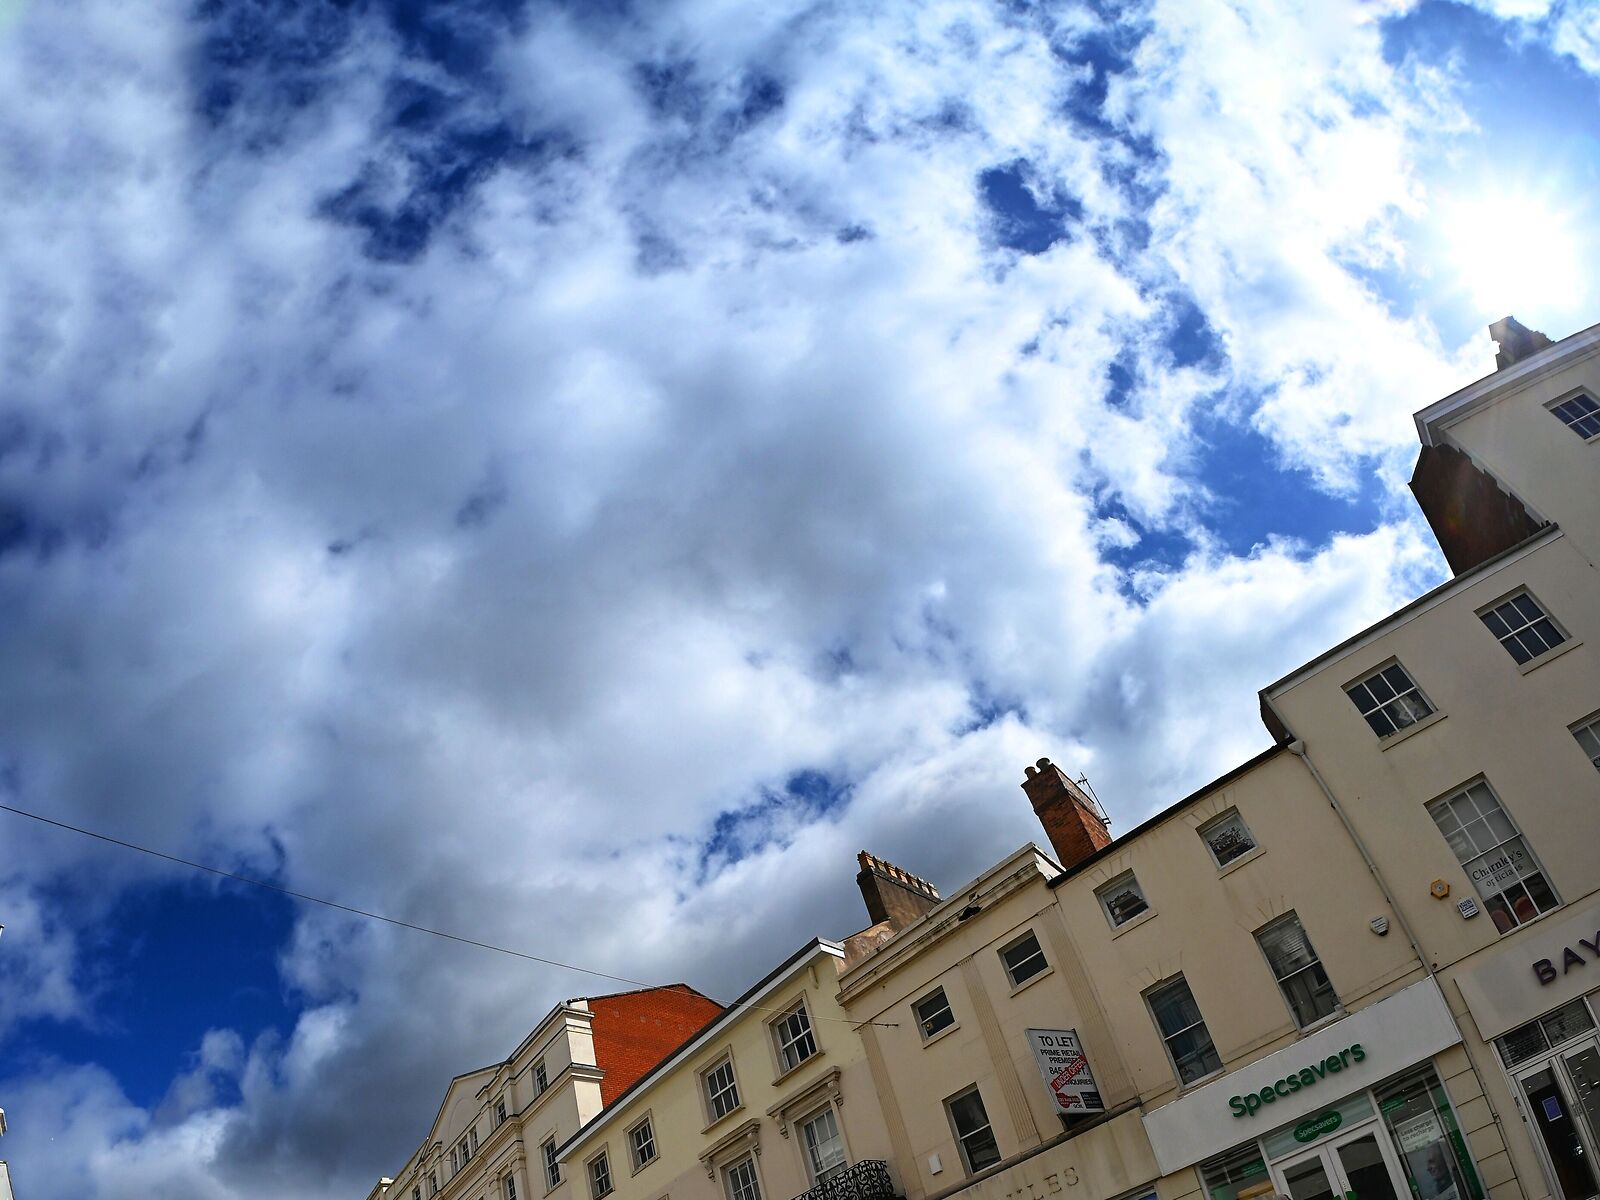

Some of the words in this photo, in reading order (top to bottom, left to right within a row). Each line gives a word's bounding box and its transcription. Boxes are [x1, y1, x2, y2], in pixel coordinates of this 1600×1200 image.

[1472, 849, 1523, 882] Charnley's
[1038, 1035, 1054, 1047] TO
[1055, 1036, 1074, 1047] LET
[1040, 1048, 1060, 1057] PRIME
[1049, 1066, 1063, 1075] 845
[1229, 1043, 1366, 1118] Specsavers
[1298, 1115, 1338, 1139] Specsavers
